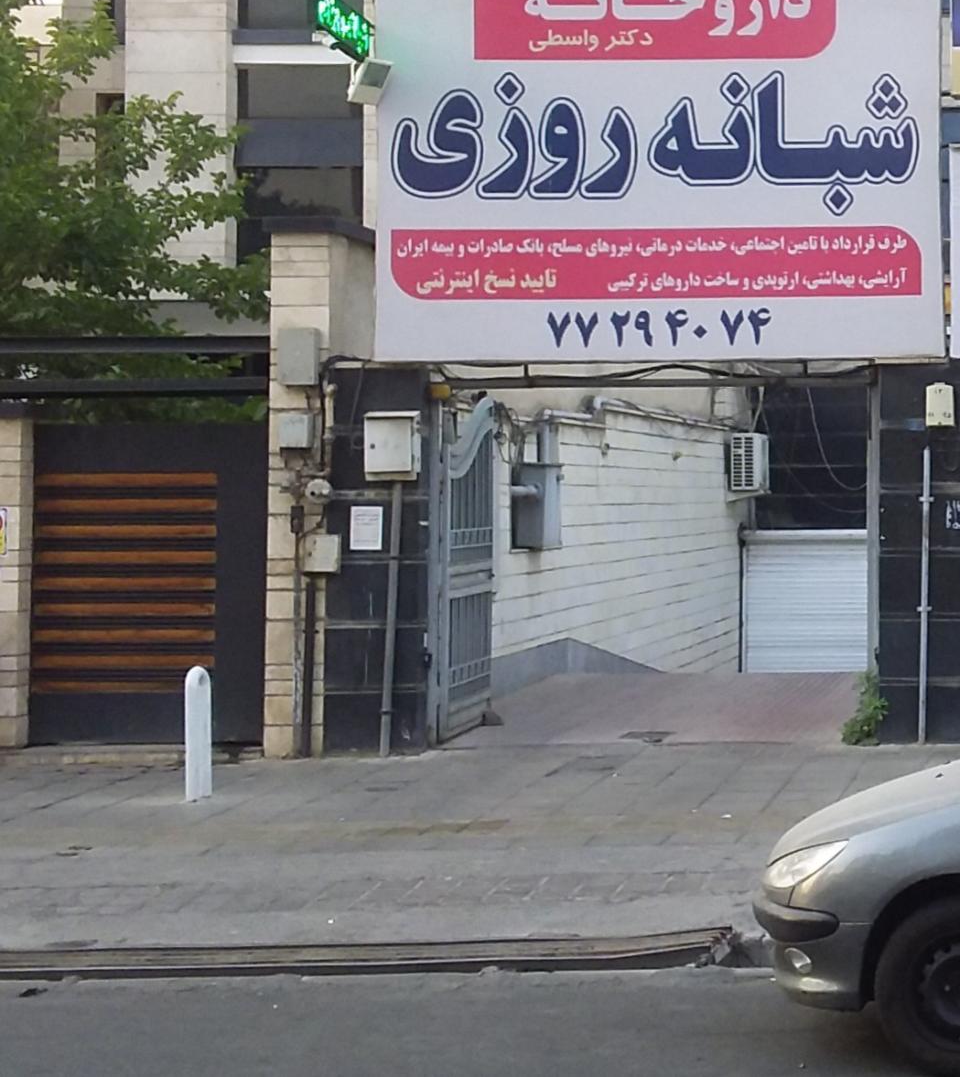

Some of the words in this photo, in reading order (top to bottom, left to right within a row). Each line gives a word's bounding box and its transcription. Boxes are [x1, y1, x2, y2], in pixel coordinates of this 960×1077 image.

[528, 29, 601, 52] واسطی
[604, 29, 653, 52] دکتر
[391, 72, 638, 200] روزی
[647, 69, 919, 216] شبانه
[397, 237, 428, 258] ایران
[431, 239, 454, 258] بیمه
[457, 243, 465, 258] و
[467, 237, 514, 258] صادرات
[516, 238, 544, 258] بانک
[586, 236, 633, 258] نیروهای
[685, 236, 727, 253] خدمات
[787, 235, 818, 255] تامین
[820, 235, 829, 252] با
[831, 234, 875, 256] قرارداد
[878, 234, 907, 254] طرف
[416, 268, 479, 295] اینترنتی
[484, 268, 515, 293] نسخ
[520, 269, 557, 293] تایید
[607, 272, 649, 293] ترکیبی
[651, 272, 700, 292] داروهای
[703, 272, 739, 287] ساخت
[742, 277, 749, 291] و
